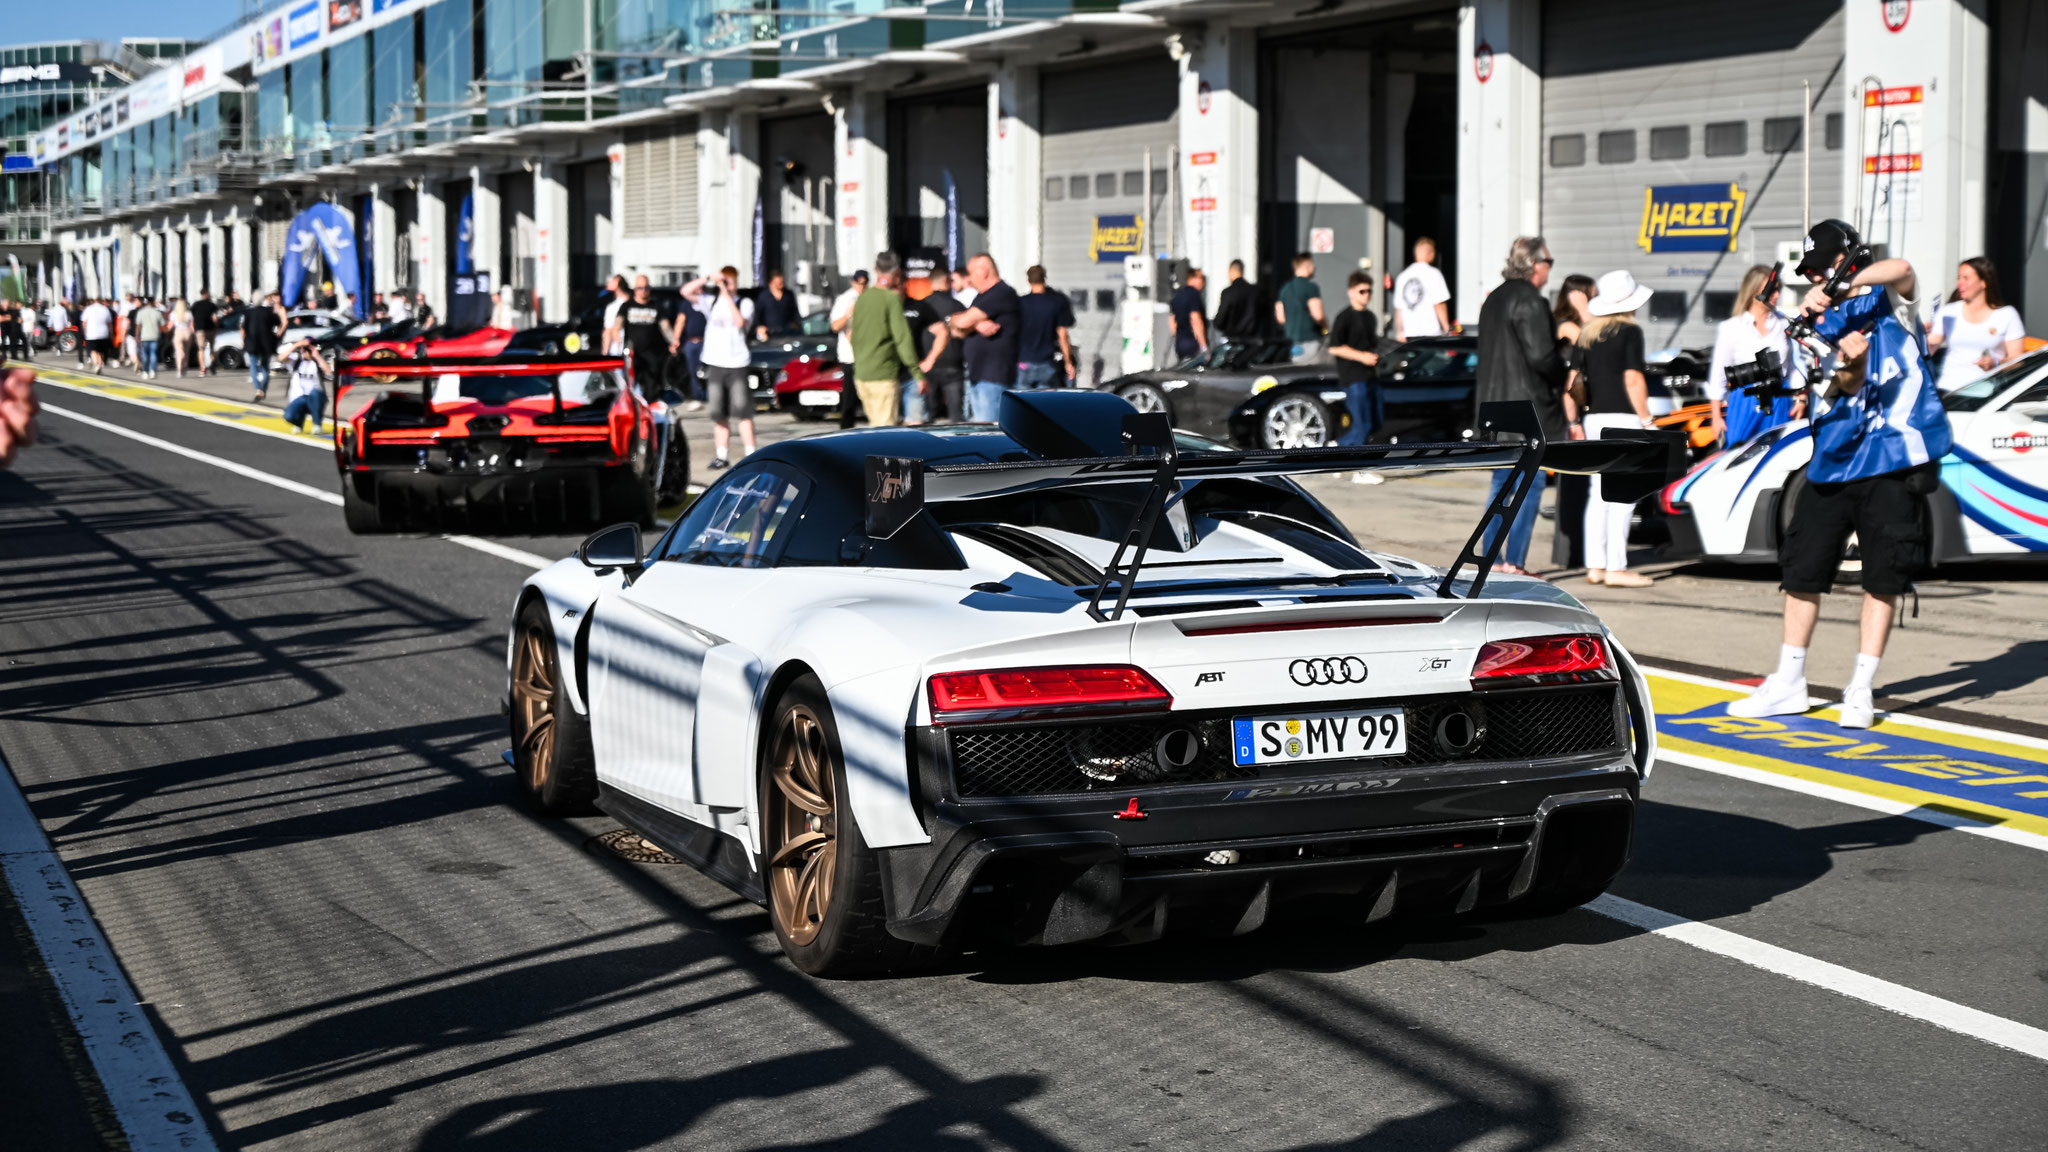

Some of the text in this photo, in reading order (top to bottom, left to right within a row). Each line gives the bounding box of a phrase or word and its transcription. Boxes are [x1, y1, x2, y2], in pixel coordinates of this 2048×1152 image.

[1648, 202, 1734, 237] HAZET
[1194, 671, 1226, 687] ABT
[1241, 713, 1399, 758] D S MY 99
